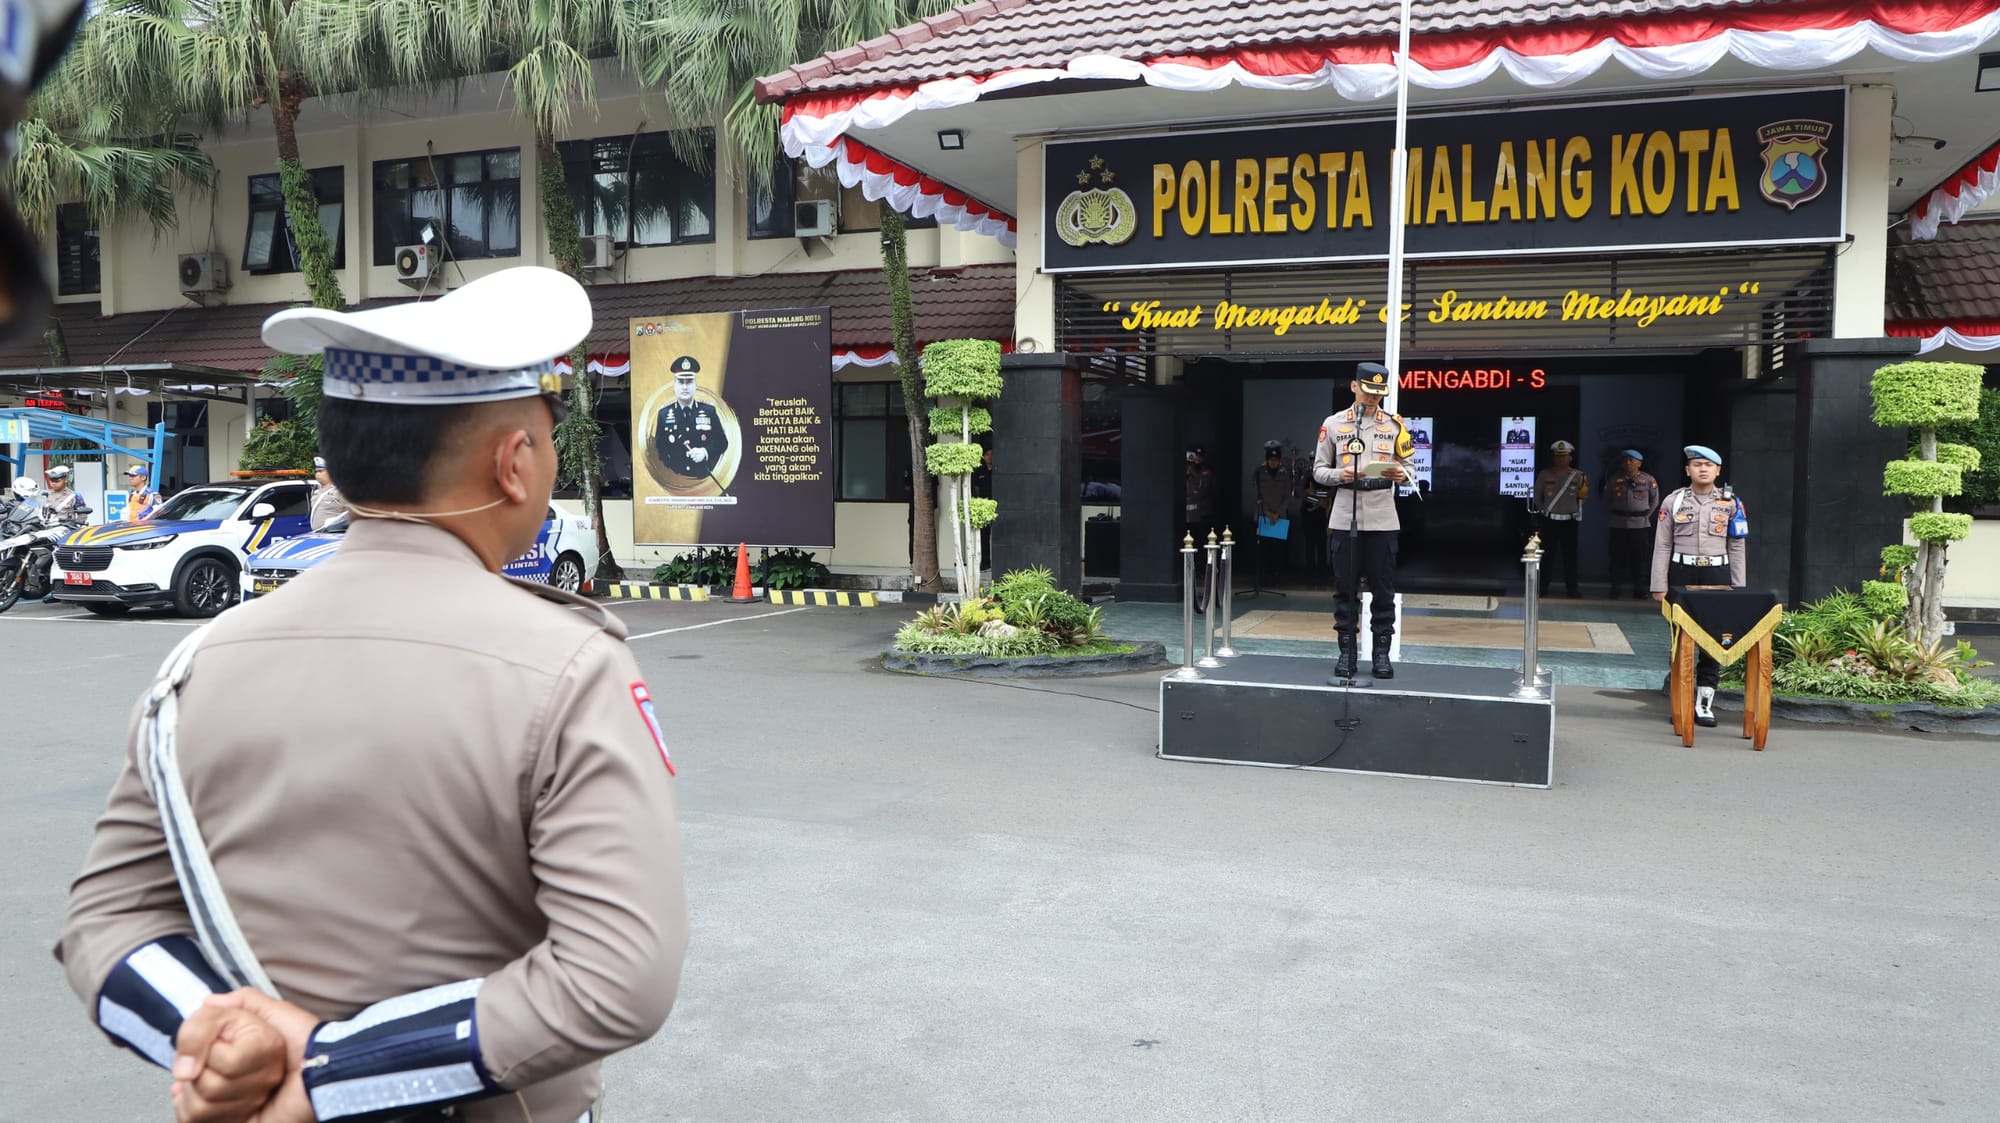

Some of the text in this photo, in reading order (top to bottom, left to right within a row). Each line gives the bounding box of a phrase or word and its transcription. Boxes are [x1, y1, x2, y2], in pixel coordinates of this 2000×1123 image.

[1765, 124, 1825, 136] JAWA TIMUR
[1152, 127, 1740, 238] POLRESTA MALANG KOTA
[1214, 297, 1366, 336] Mengabdi
[1428, 290, 1548, 323] Santun
[777, 315, 804, 323] MALANG
[804, 314, 822, 322] KOTA
[1398, 370, 1511, 390] MENGABDI
[1530, 369, 1546, 388] S
[759, 407, 815, 416] Berbuat BAIK
[753, 416, 821, 426] BERKATA BAIK &
[766, 426, 807, 434] HATI BAIK
[760, 435, 815, 444] karena akan
[755, 444, 820, 453] DIKENANG oleh
[759, 455, 816, 465] orang-orang
[765, 463, 811, 474] yang akan
[754, 472, 770, 480] kita
[510, 561, 539, 569] LINTAS
